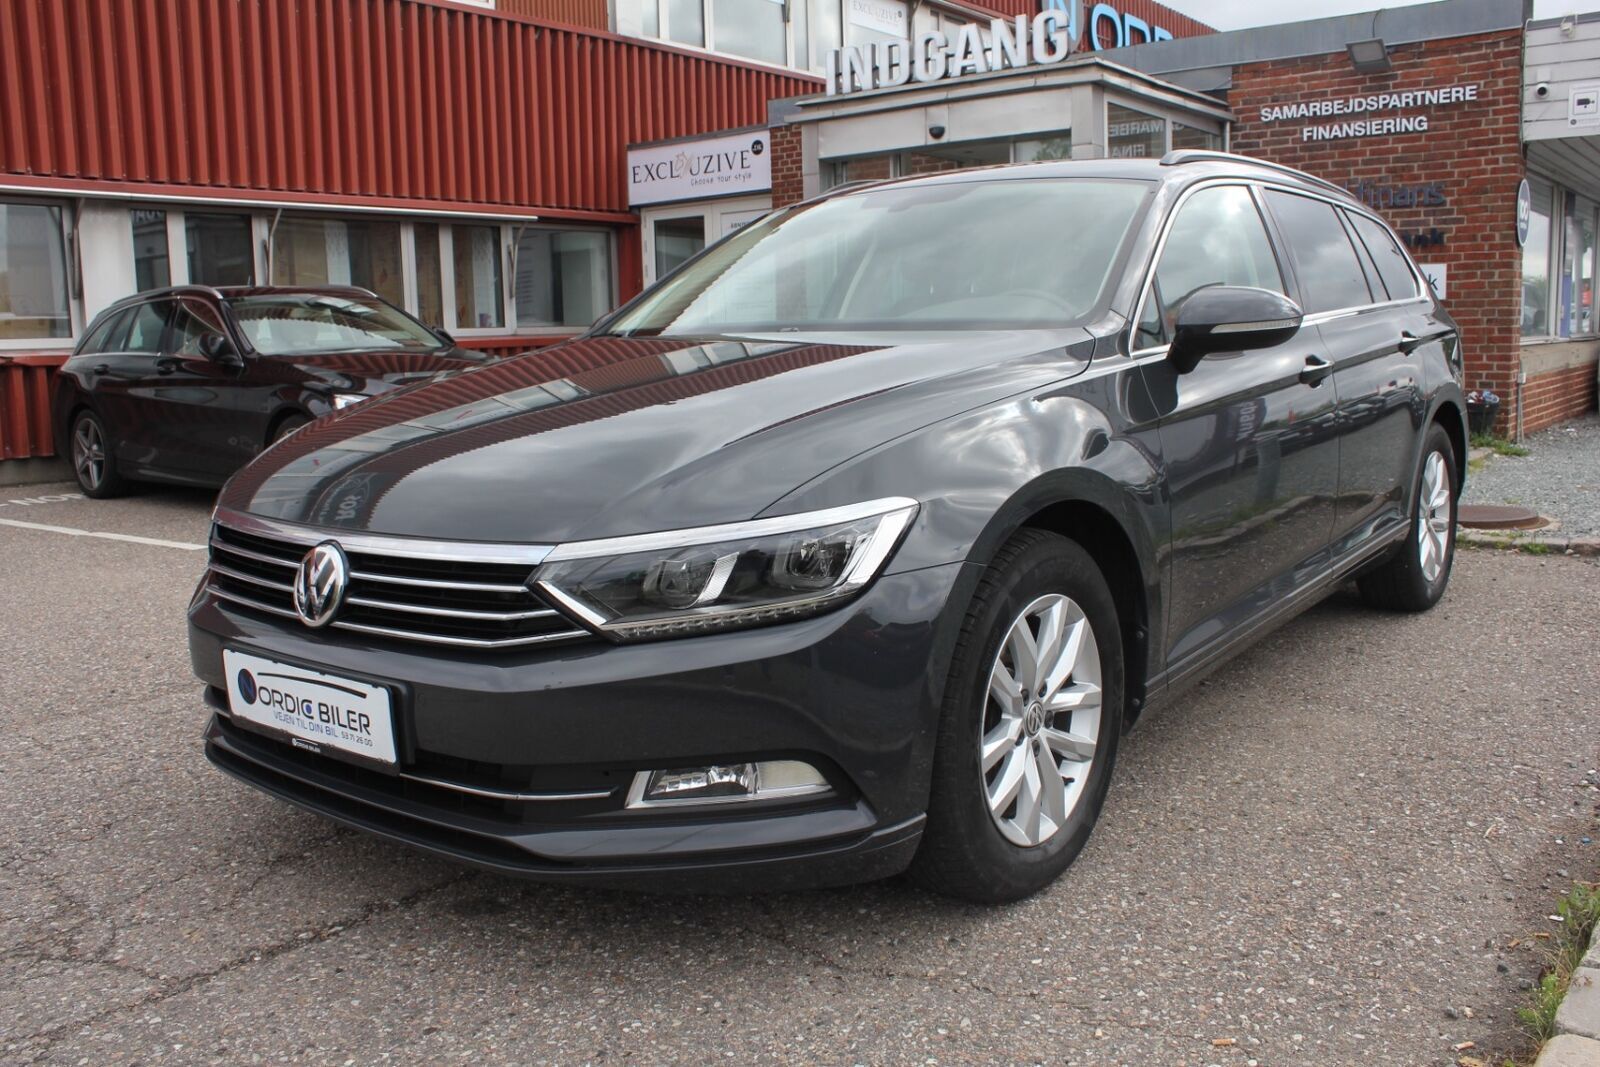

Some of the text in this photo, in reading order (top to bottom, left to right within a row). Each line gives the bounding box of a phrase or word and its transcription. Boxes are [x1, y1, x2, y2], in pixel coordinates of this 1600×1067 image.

[825, 9, 1070, 96] INDGANG
[1260, 84, 1478, 123] SAMARBEJDSPARTNERE
[1302, 115, 1428, 142] FINANSIERING
[318, 702, 371, 736] BILER
[325, 725, 339, 739] BIL
